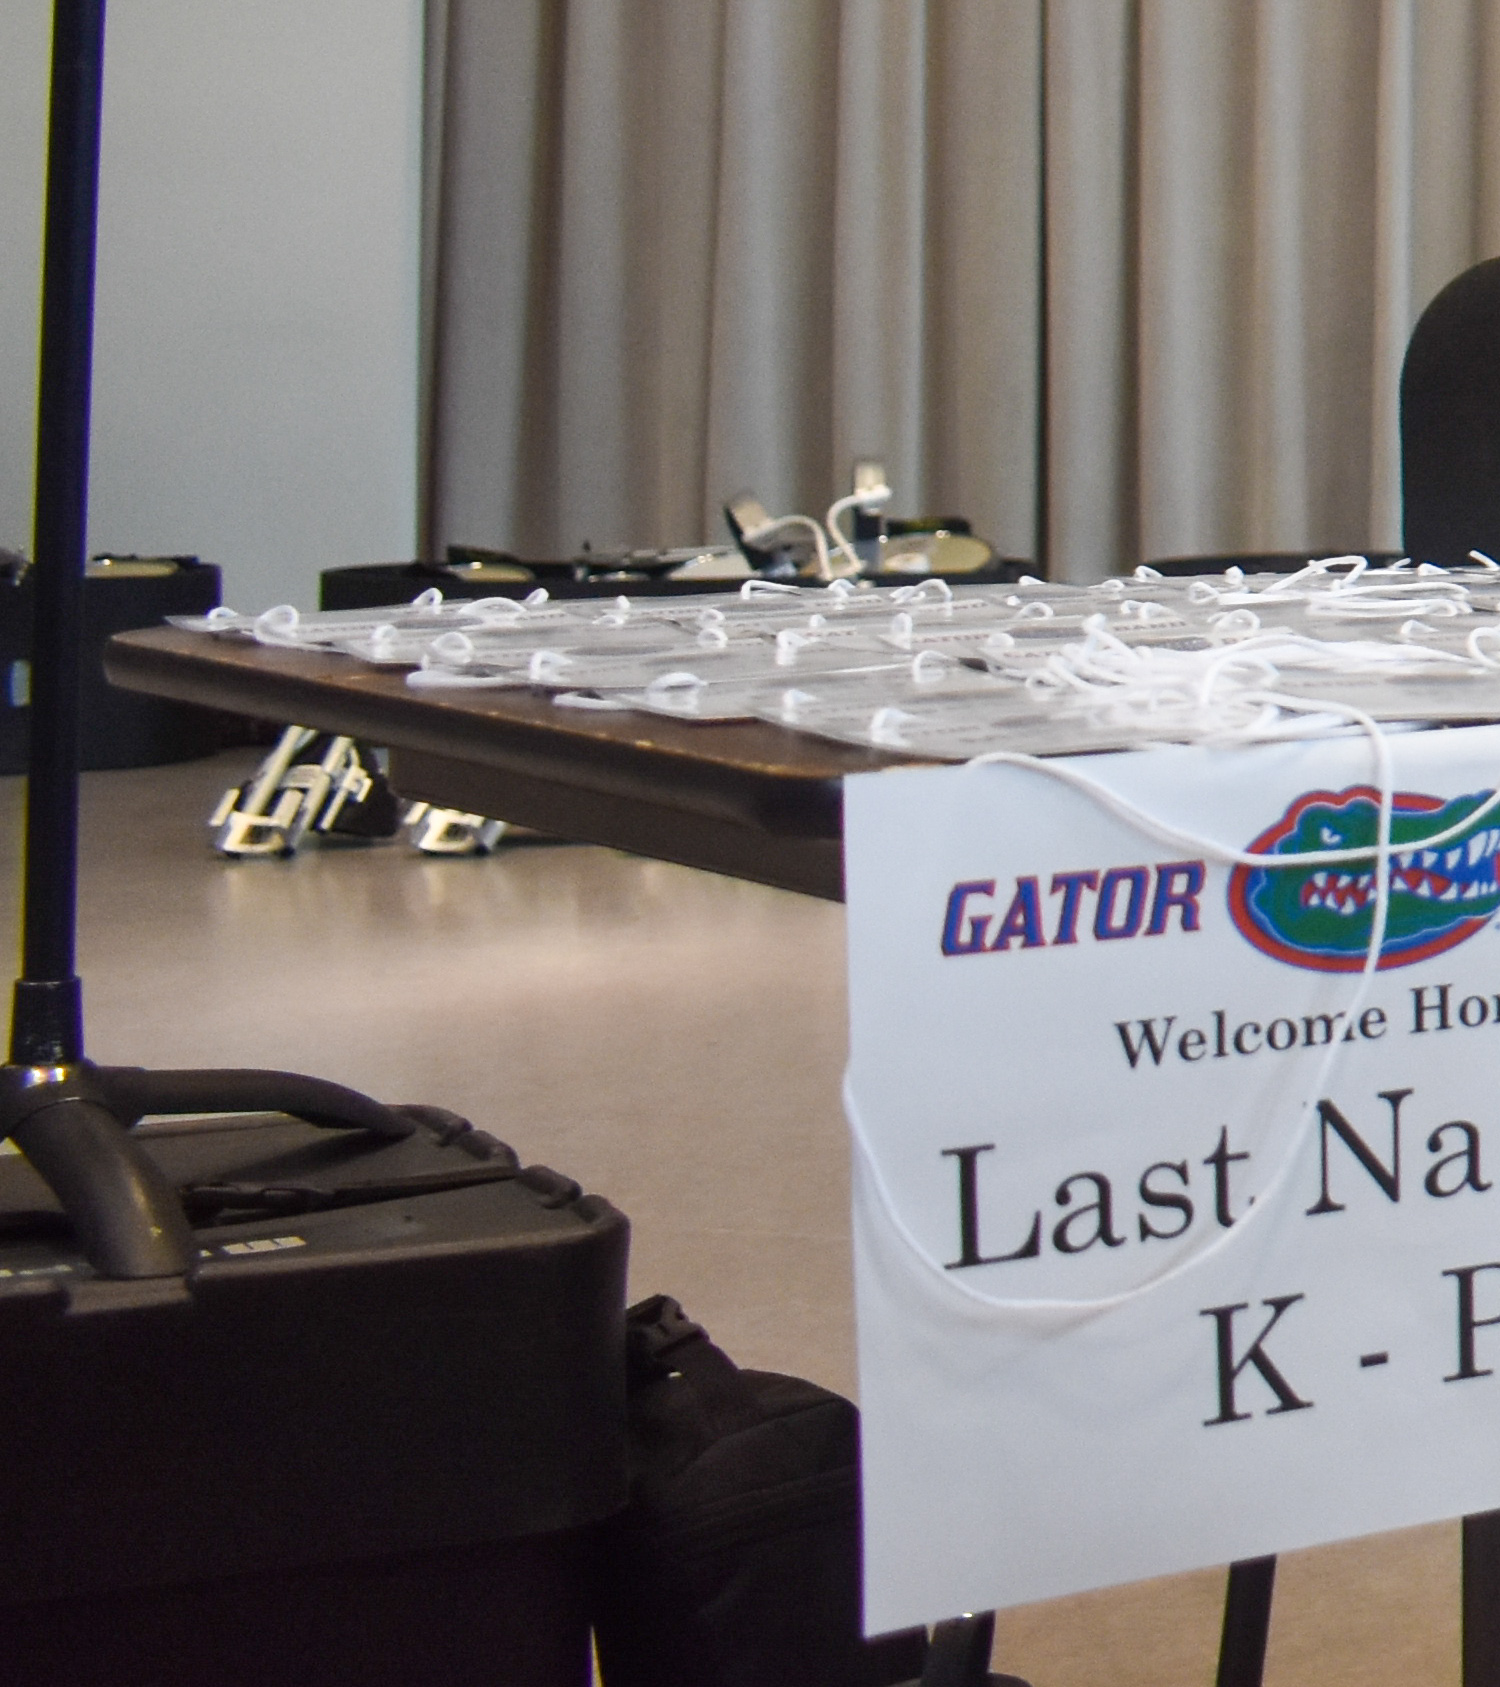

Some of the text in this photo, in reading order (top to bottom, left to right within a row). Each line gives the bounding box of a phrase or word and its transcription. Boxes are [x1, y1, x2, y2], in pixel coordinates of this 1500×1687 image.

[939, 860, 1205, 957] GATOR
[1114, 1008, 1388, 1069] Welcome
[940, 1124, 1251, 1270] Last
[1200, 1293, 1314, 1427] K
